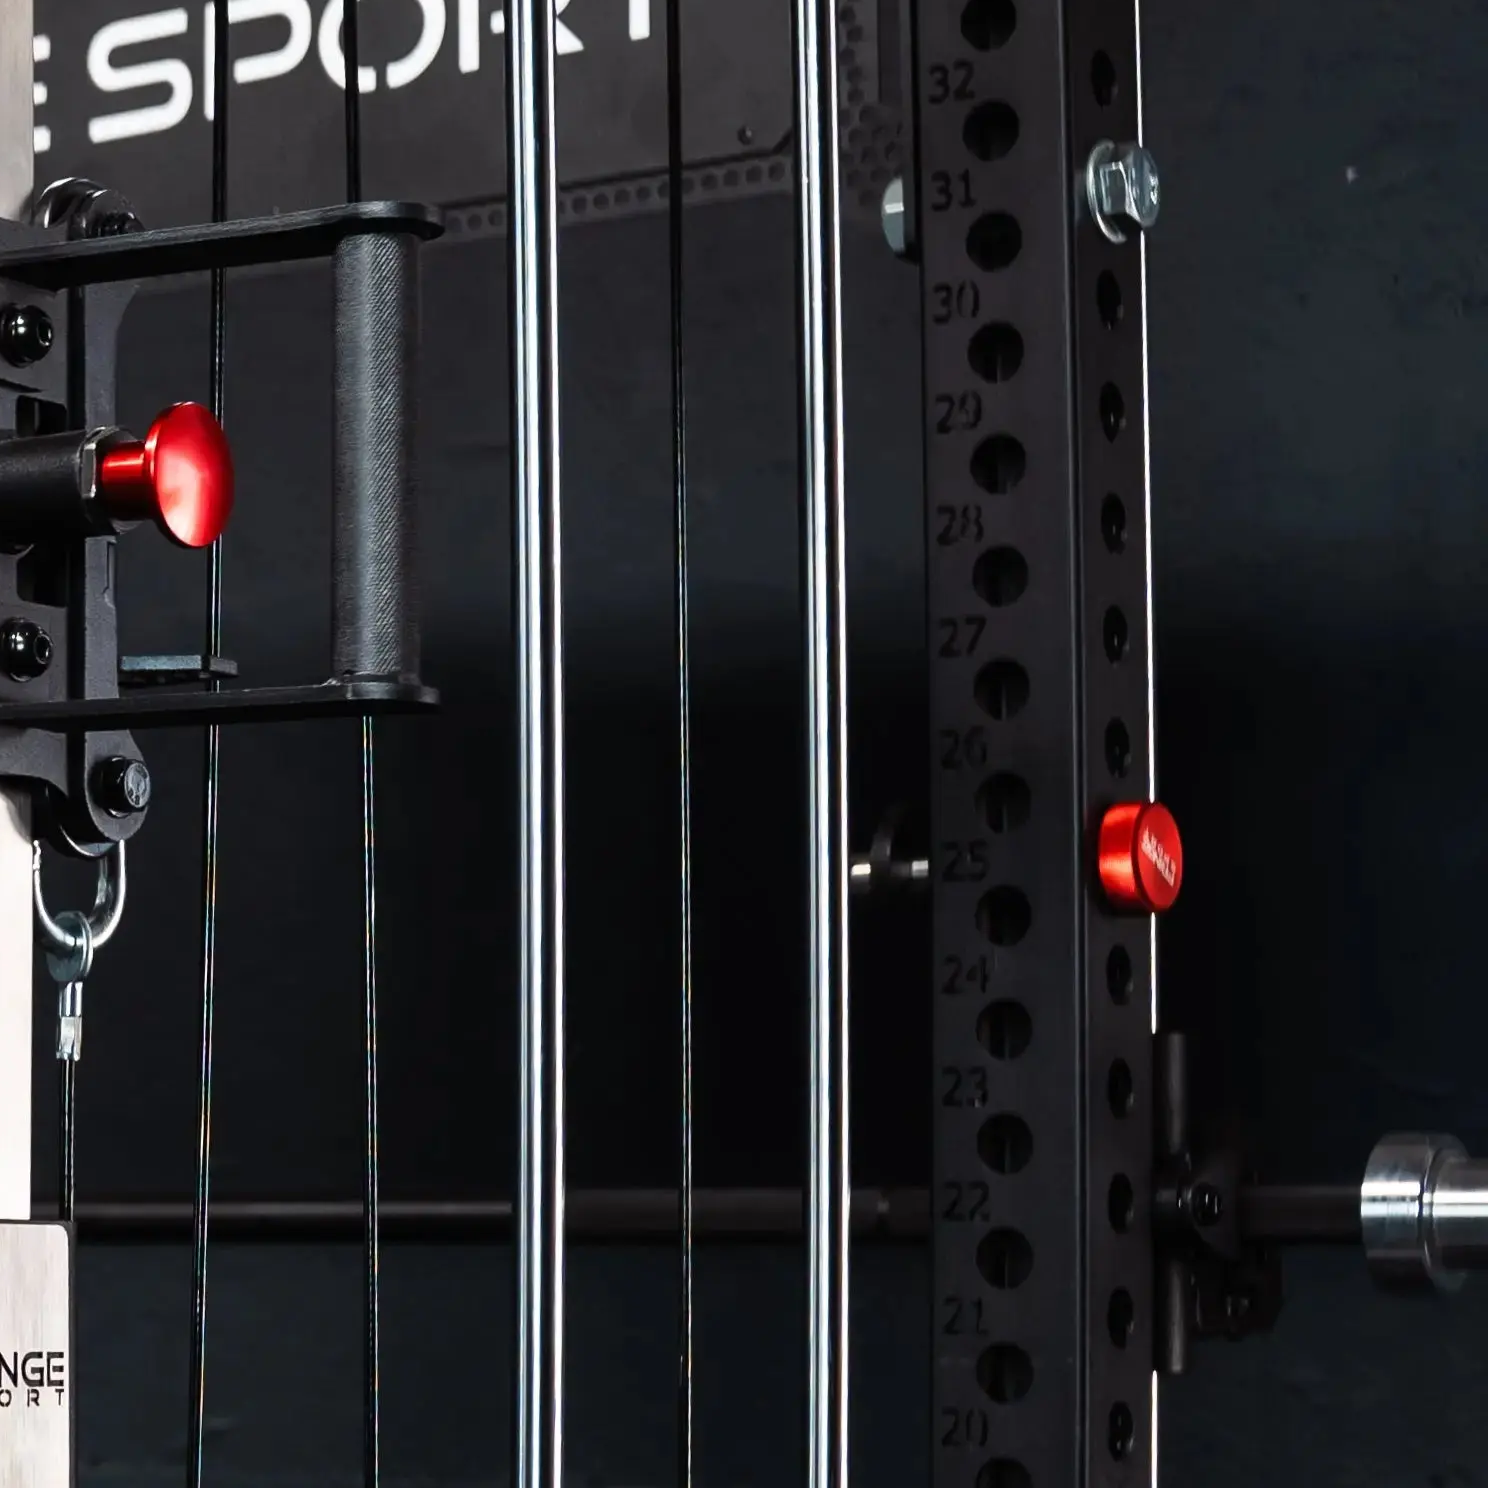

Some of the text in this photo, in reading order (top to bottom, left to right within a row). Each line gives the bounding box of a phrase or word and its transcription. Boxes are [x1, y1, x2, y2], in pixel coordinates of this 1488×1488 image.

[928, 65, 975, 104] 32
[931, 172, 977, 209] 31
[932, 281, 979, 321] 30
[936, 392, 981, 434] 29
[936, 503, 983, 546] 28
[938, 616, 986, 658] 27
[939, 728, 988, 769] 26
[940, 841, 989, 882] 25
[941, 955, 990, 995] 24
[941, 1067, 989, 1109] 23
[942, 1181, 991, 1224] 22
[942, 1296, 989, 1337] 21
[941, 1408, 989, 1449] 20
